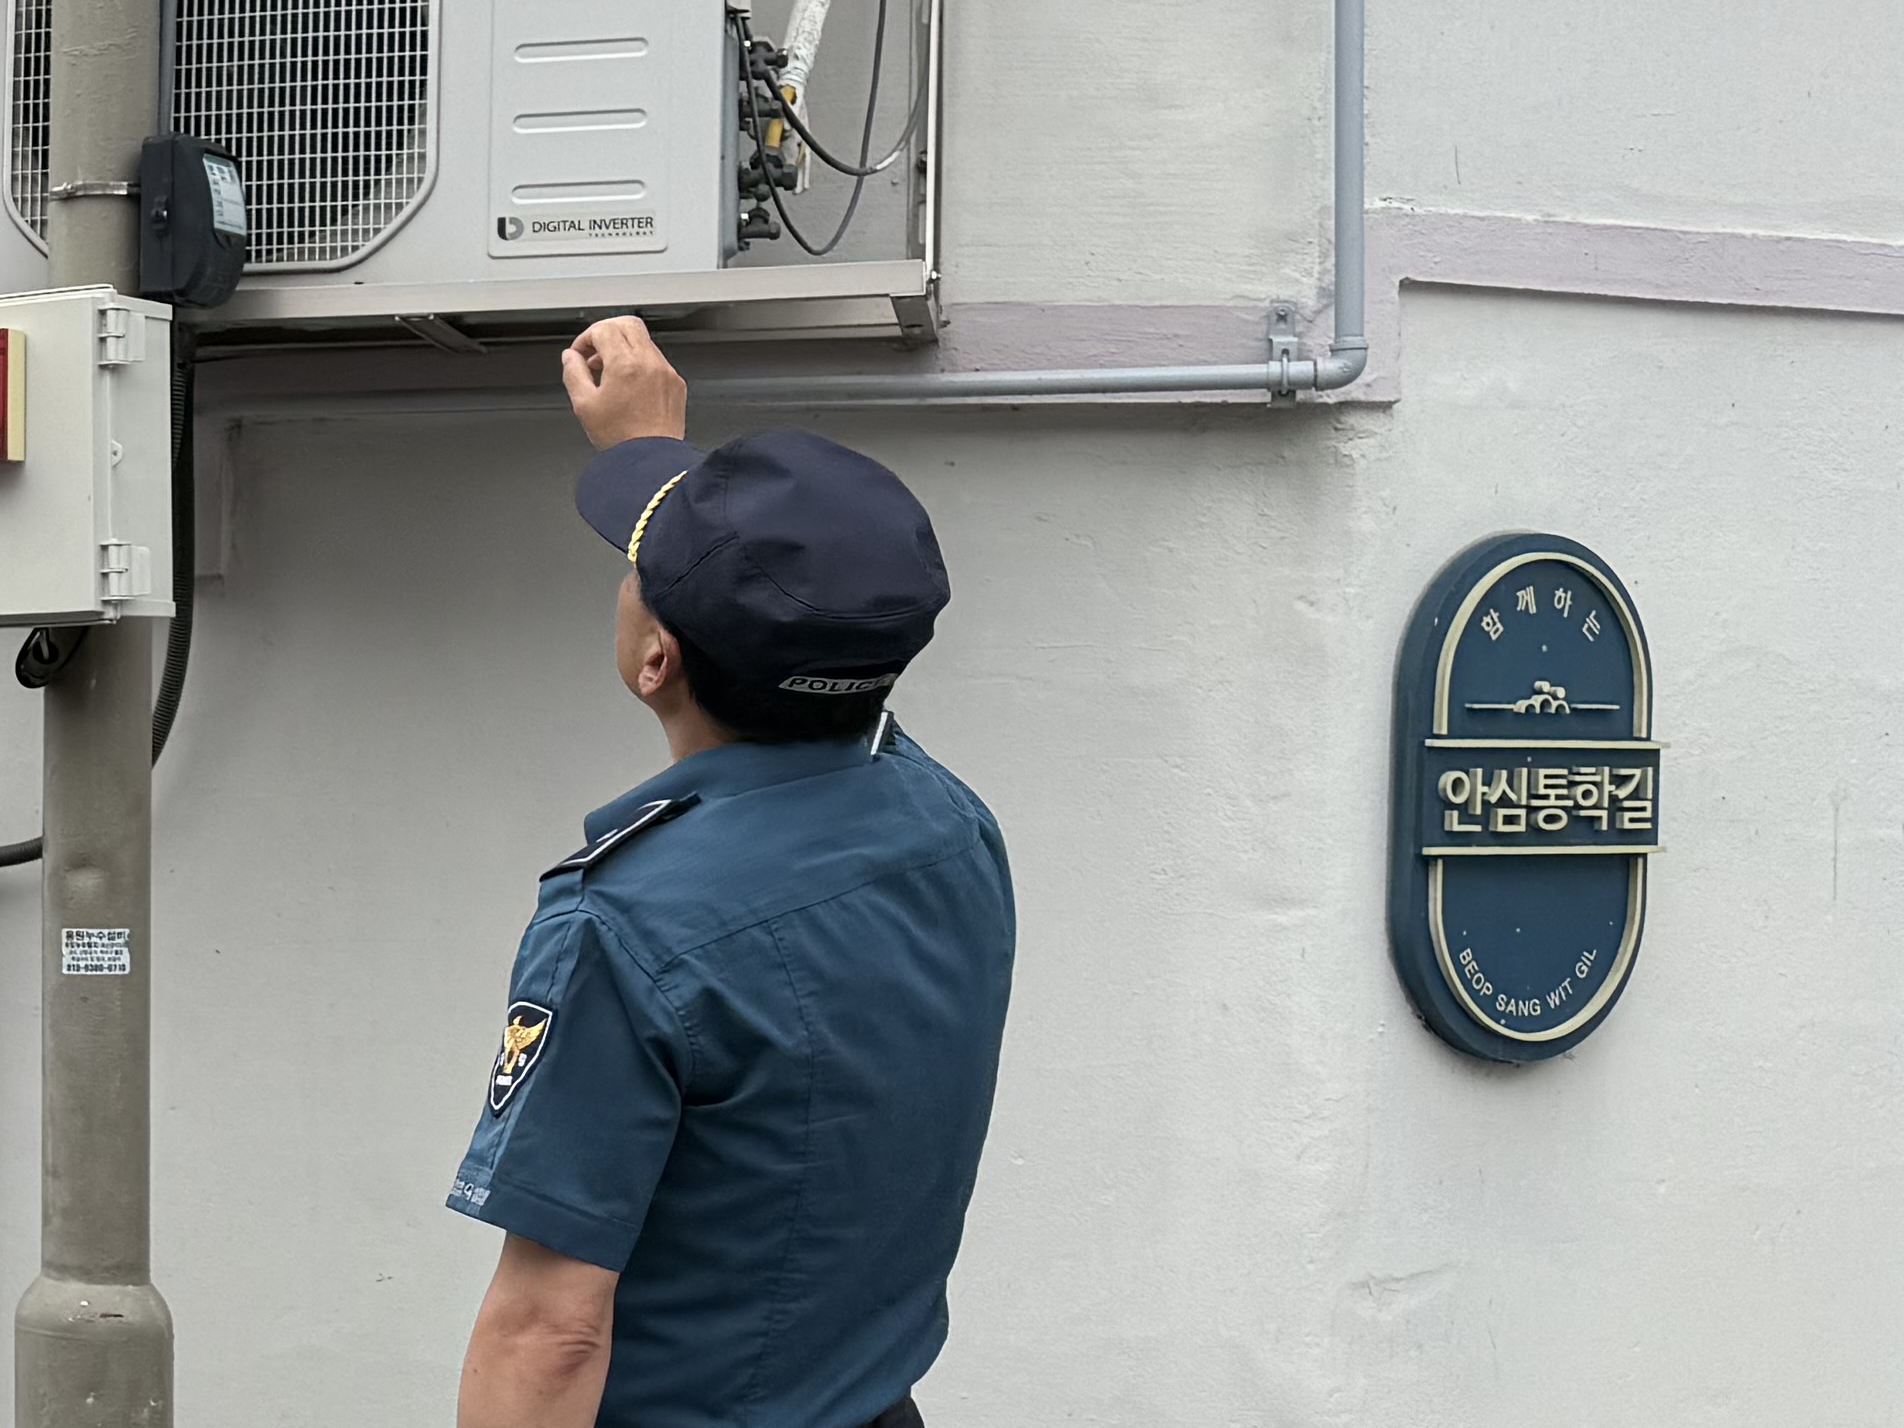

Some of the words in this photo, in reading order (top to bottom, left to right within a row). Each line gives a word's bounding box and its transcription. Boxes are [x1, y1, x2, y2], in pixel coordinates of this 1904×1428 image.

[532, 220, 585, 233] DIGITAL
[589, 216, 654, 231] INVERTER
[1438, 766, 1654, 833] 안심통학길
[1459, 947, 1494, 999] BEOP
[1496, 993, 1542, 1018] SANG
[1546, 979, 1574, 1010] WIT
[1575, 946, 1598, 980] GIL
